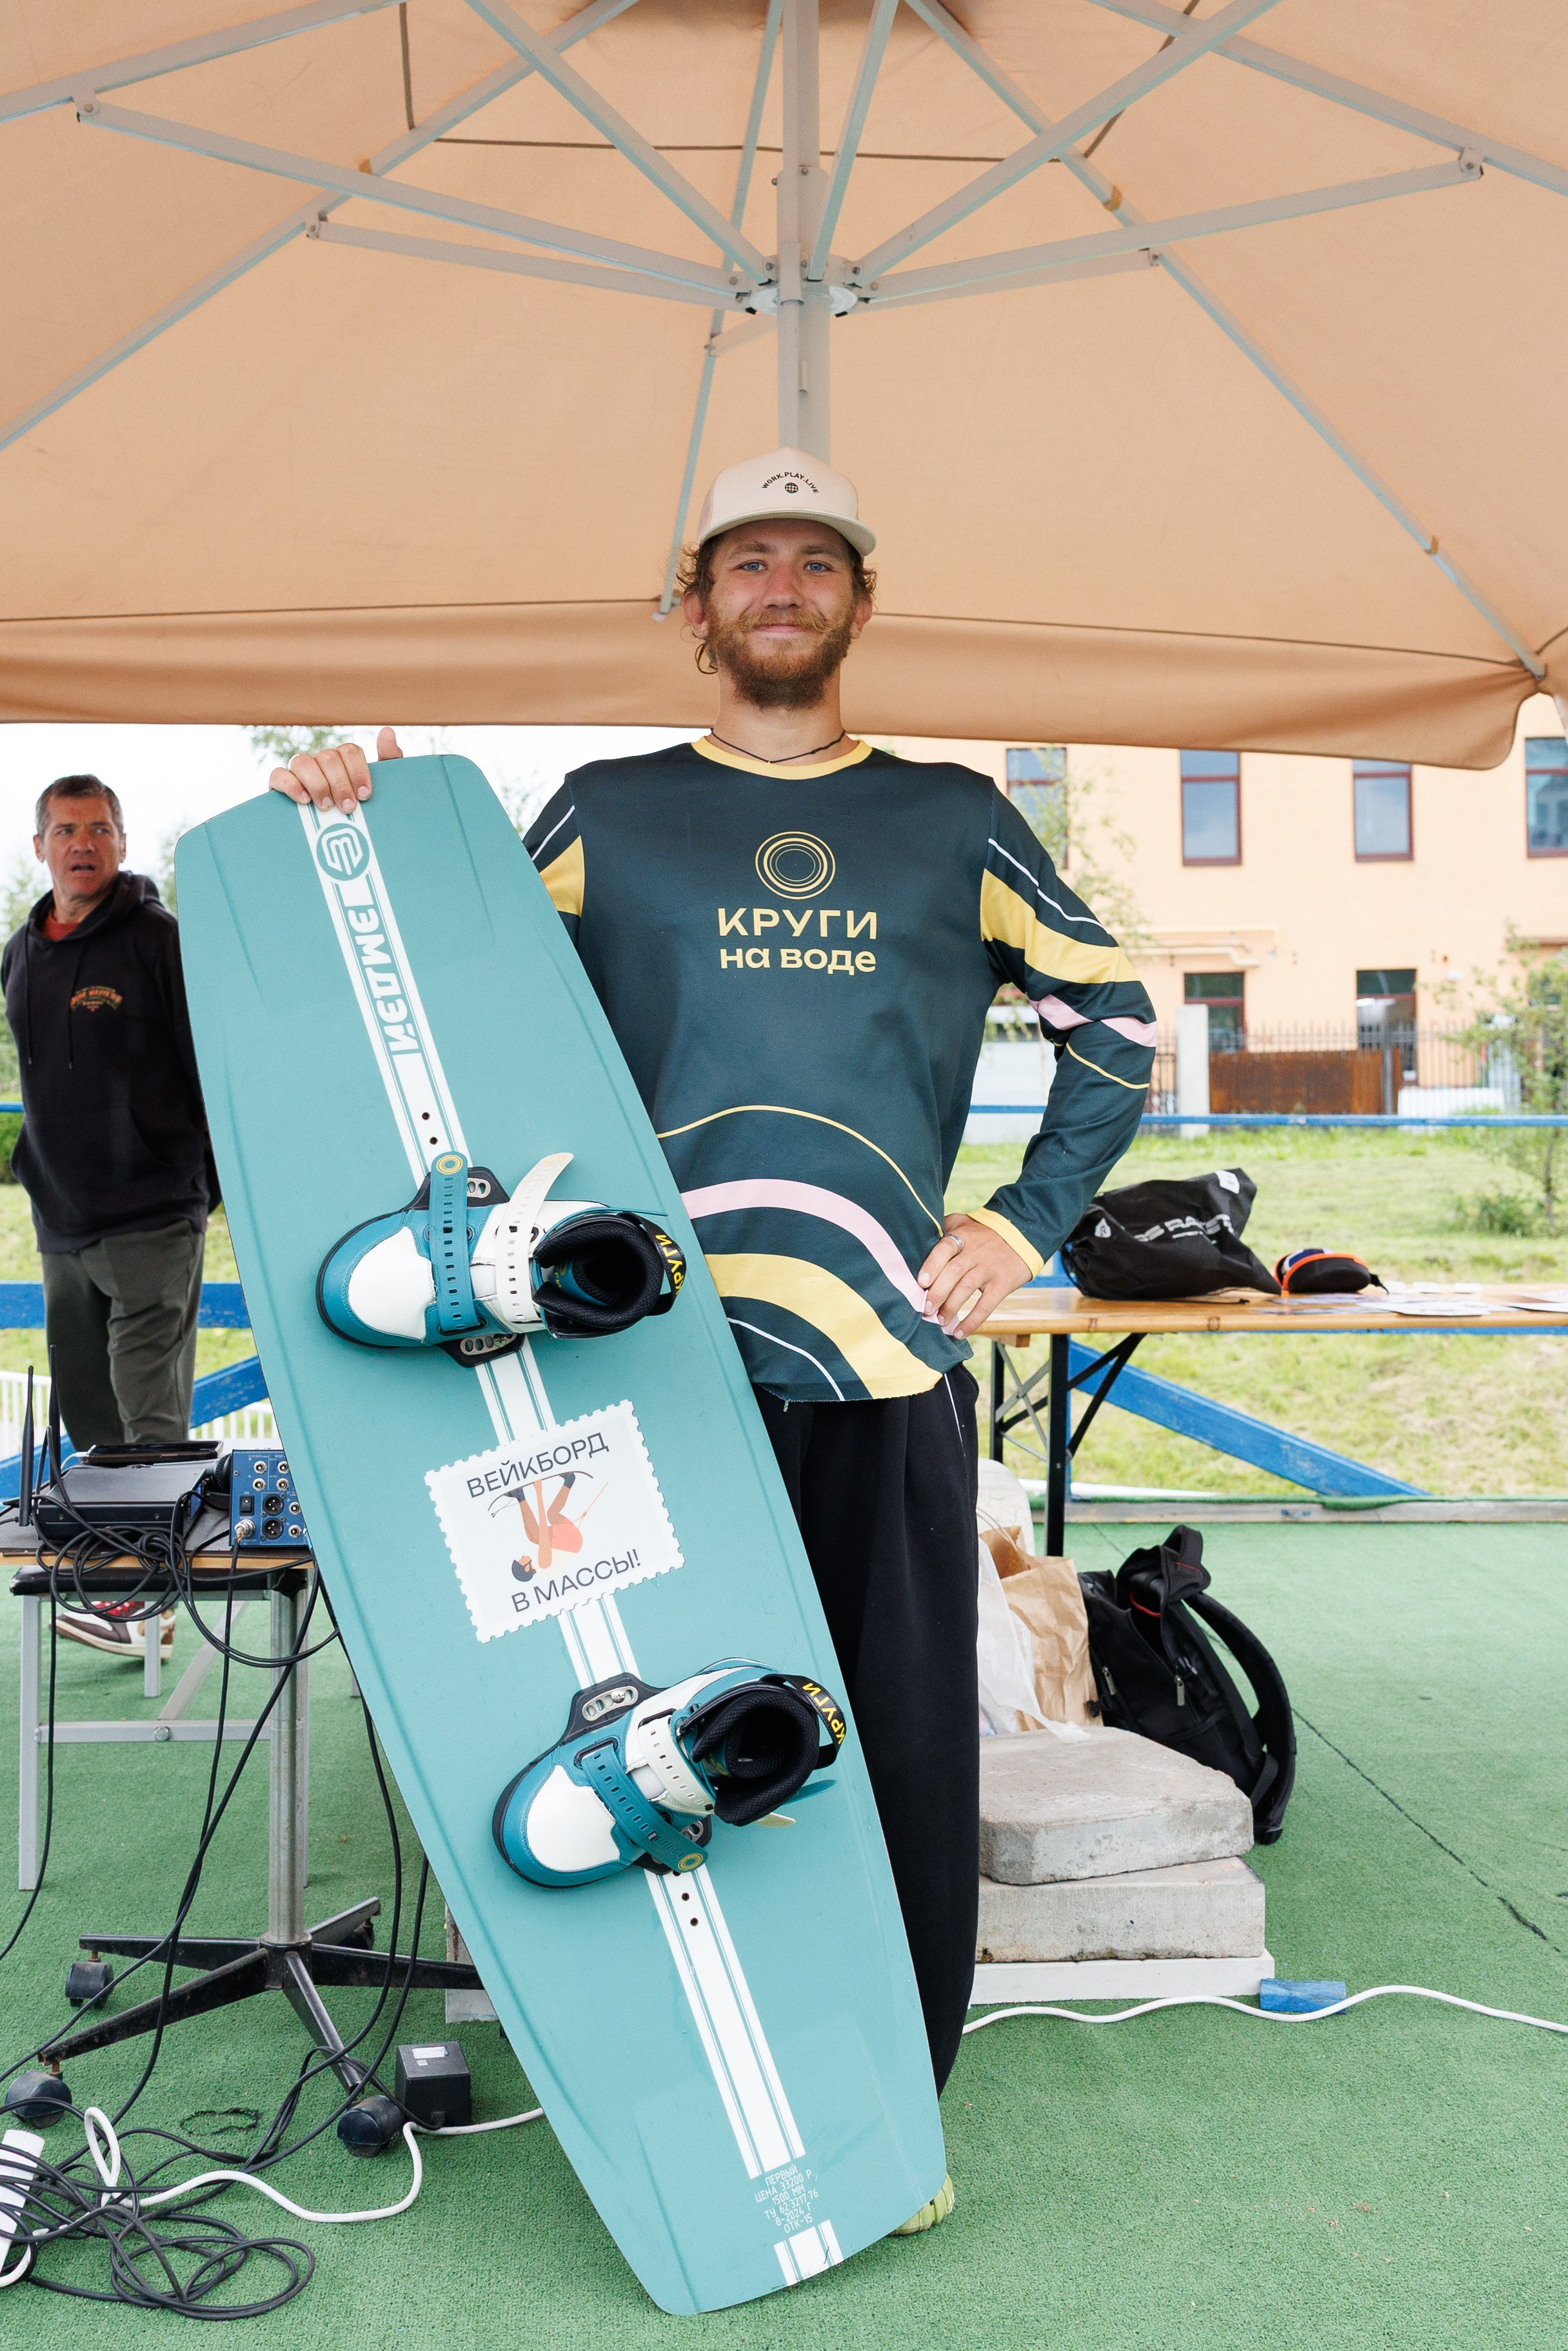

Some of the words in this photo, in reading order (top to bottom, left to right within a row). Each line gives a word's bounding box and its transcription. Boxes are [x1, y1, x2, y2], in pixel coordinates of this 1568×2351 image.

[762, 471, 819, 493] WORK.PLAY.LIVE
[718, 908, 877, 940] КРУГИ
[720, 947, 771, 969] на
[780, 948, 877, 976] воде
[348, 908, 419, 1052] ЭМДЭЙ
[466, 1432, 610, 1498] ВЕЙКБОРД
[511, 1592, 530, 1612] В
[533, 1549, 641, 1605] МАССЫ!
[802, 1682, 844, 1745] КРУГИ
[755, 2186, 778, 2203] ЦЕНА
[780, 2173, 804, 2192] 33200
[765, 2164, 798, 2187] ПЕРВЫЙ
[771, 2190, 789, 2205] 1500
[791, 2183, 806, 2197] ММ
[764, 2207, 777, 2220] ТУ
[775, 2206, 805, 2227] 8-2024
[784, 2212, 813, 2234] ОТК-15
